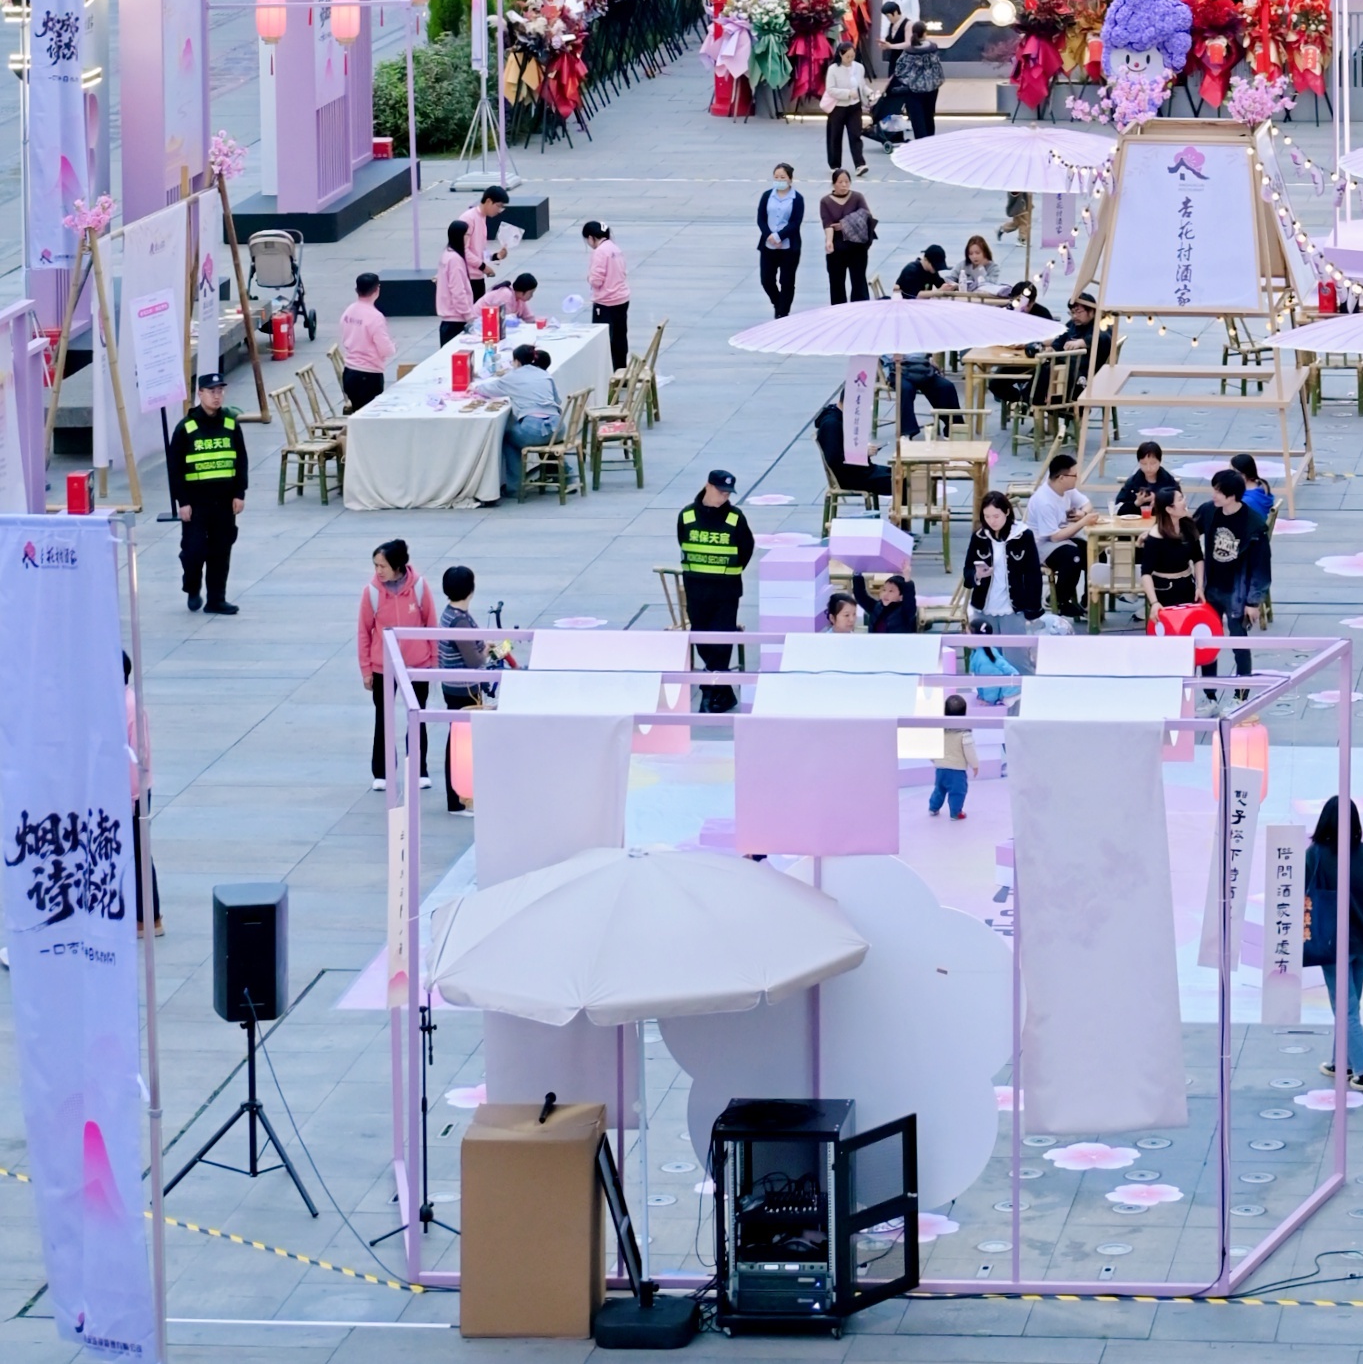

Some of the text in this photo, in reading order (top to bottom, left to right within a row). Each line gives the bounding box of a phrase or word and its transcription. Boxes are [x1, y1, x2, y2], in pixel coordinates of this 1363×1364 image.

[1174, 196, 1195, 307] 杏花村酒家
[5, 808, 122, 867] 烟火都
